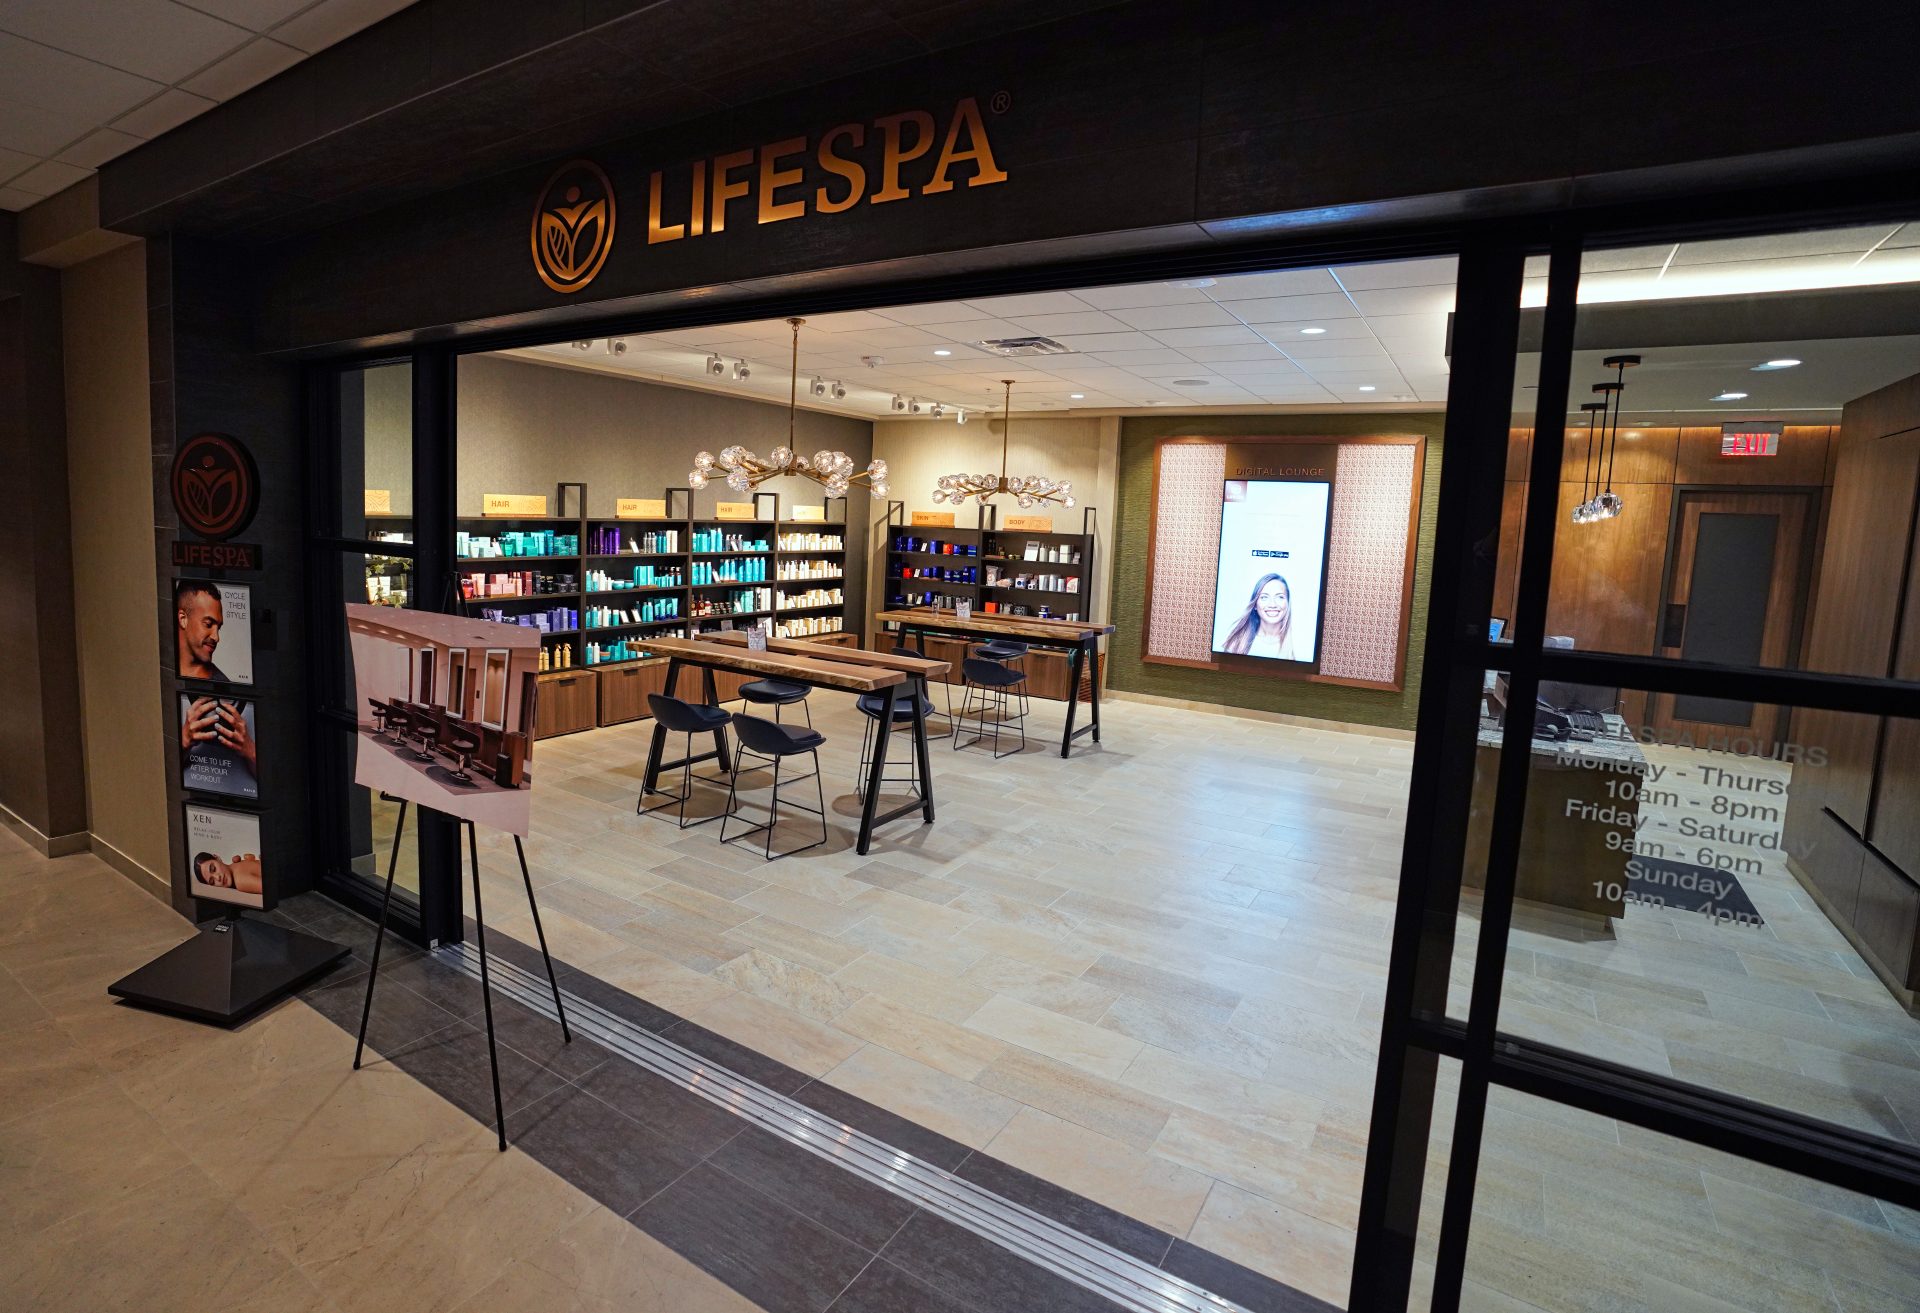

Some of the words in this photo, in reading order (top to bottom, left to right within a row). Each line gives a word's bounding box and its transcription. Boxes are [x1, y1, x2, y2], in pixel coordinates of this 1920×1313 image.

[1732, 433, 1771, 453] EXIT
[1236, 467, 1276, 476] DIGITAL
[1280, 467, 1325, 476] LOUNGE
[491, 500, 510, 508] HAIR
[622, 503, 638, 511] HAIR
[173, 543, 250, 567] LIFESPA
[224, 591, 246, 600] CYCLE
[228, 601, 246, 610] THEN
[226, 611, 247, 620] STYLE
[1707, 735, 1829, 768] HOURS
[189, 755, 208, 763] COME
[208, 757, 218, 766] TO
[218, 759, 232, 767] LIFE
[1556, 746, 1667, 782] Monday
[190, 764, 210, 773] AFTER
[211, 767, 228, 775] YOUR
[1605, 780, 1679, 808] 10am
[1710, 795, 1779, 823] 8pm
[193, 814, 212, 824] XEN
[1565, 798, 1649, 830] Friday
[1605, 831, 1665, 858] 9am
[1696, 847, 1763, 876] 6pm
[1624, 860, 1733, 900] Sunday
[1592, 881, 1665, 911] 10am
[1696, 901, 1764, 930] 4pm
